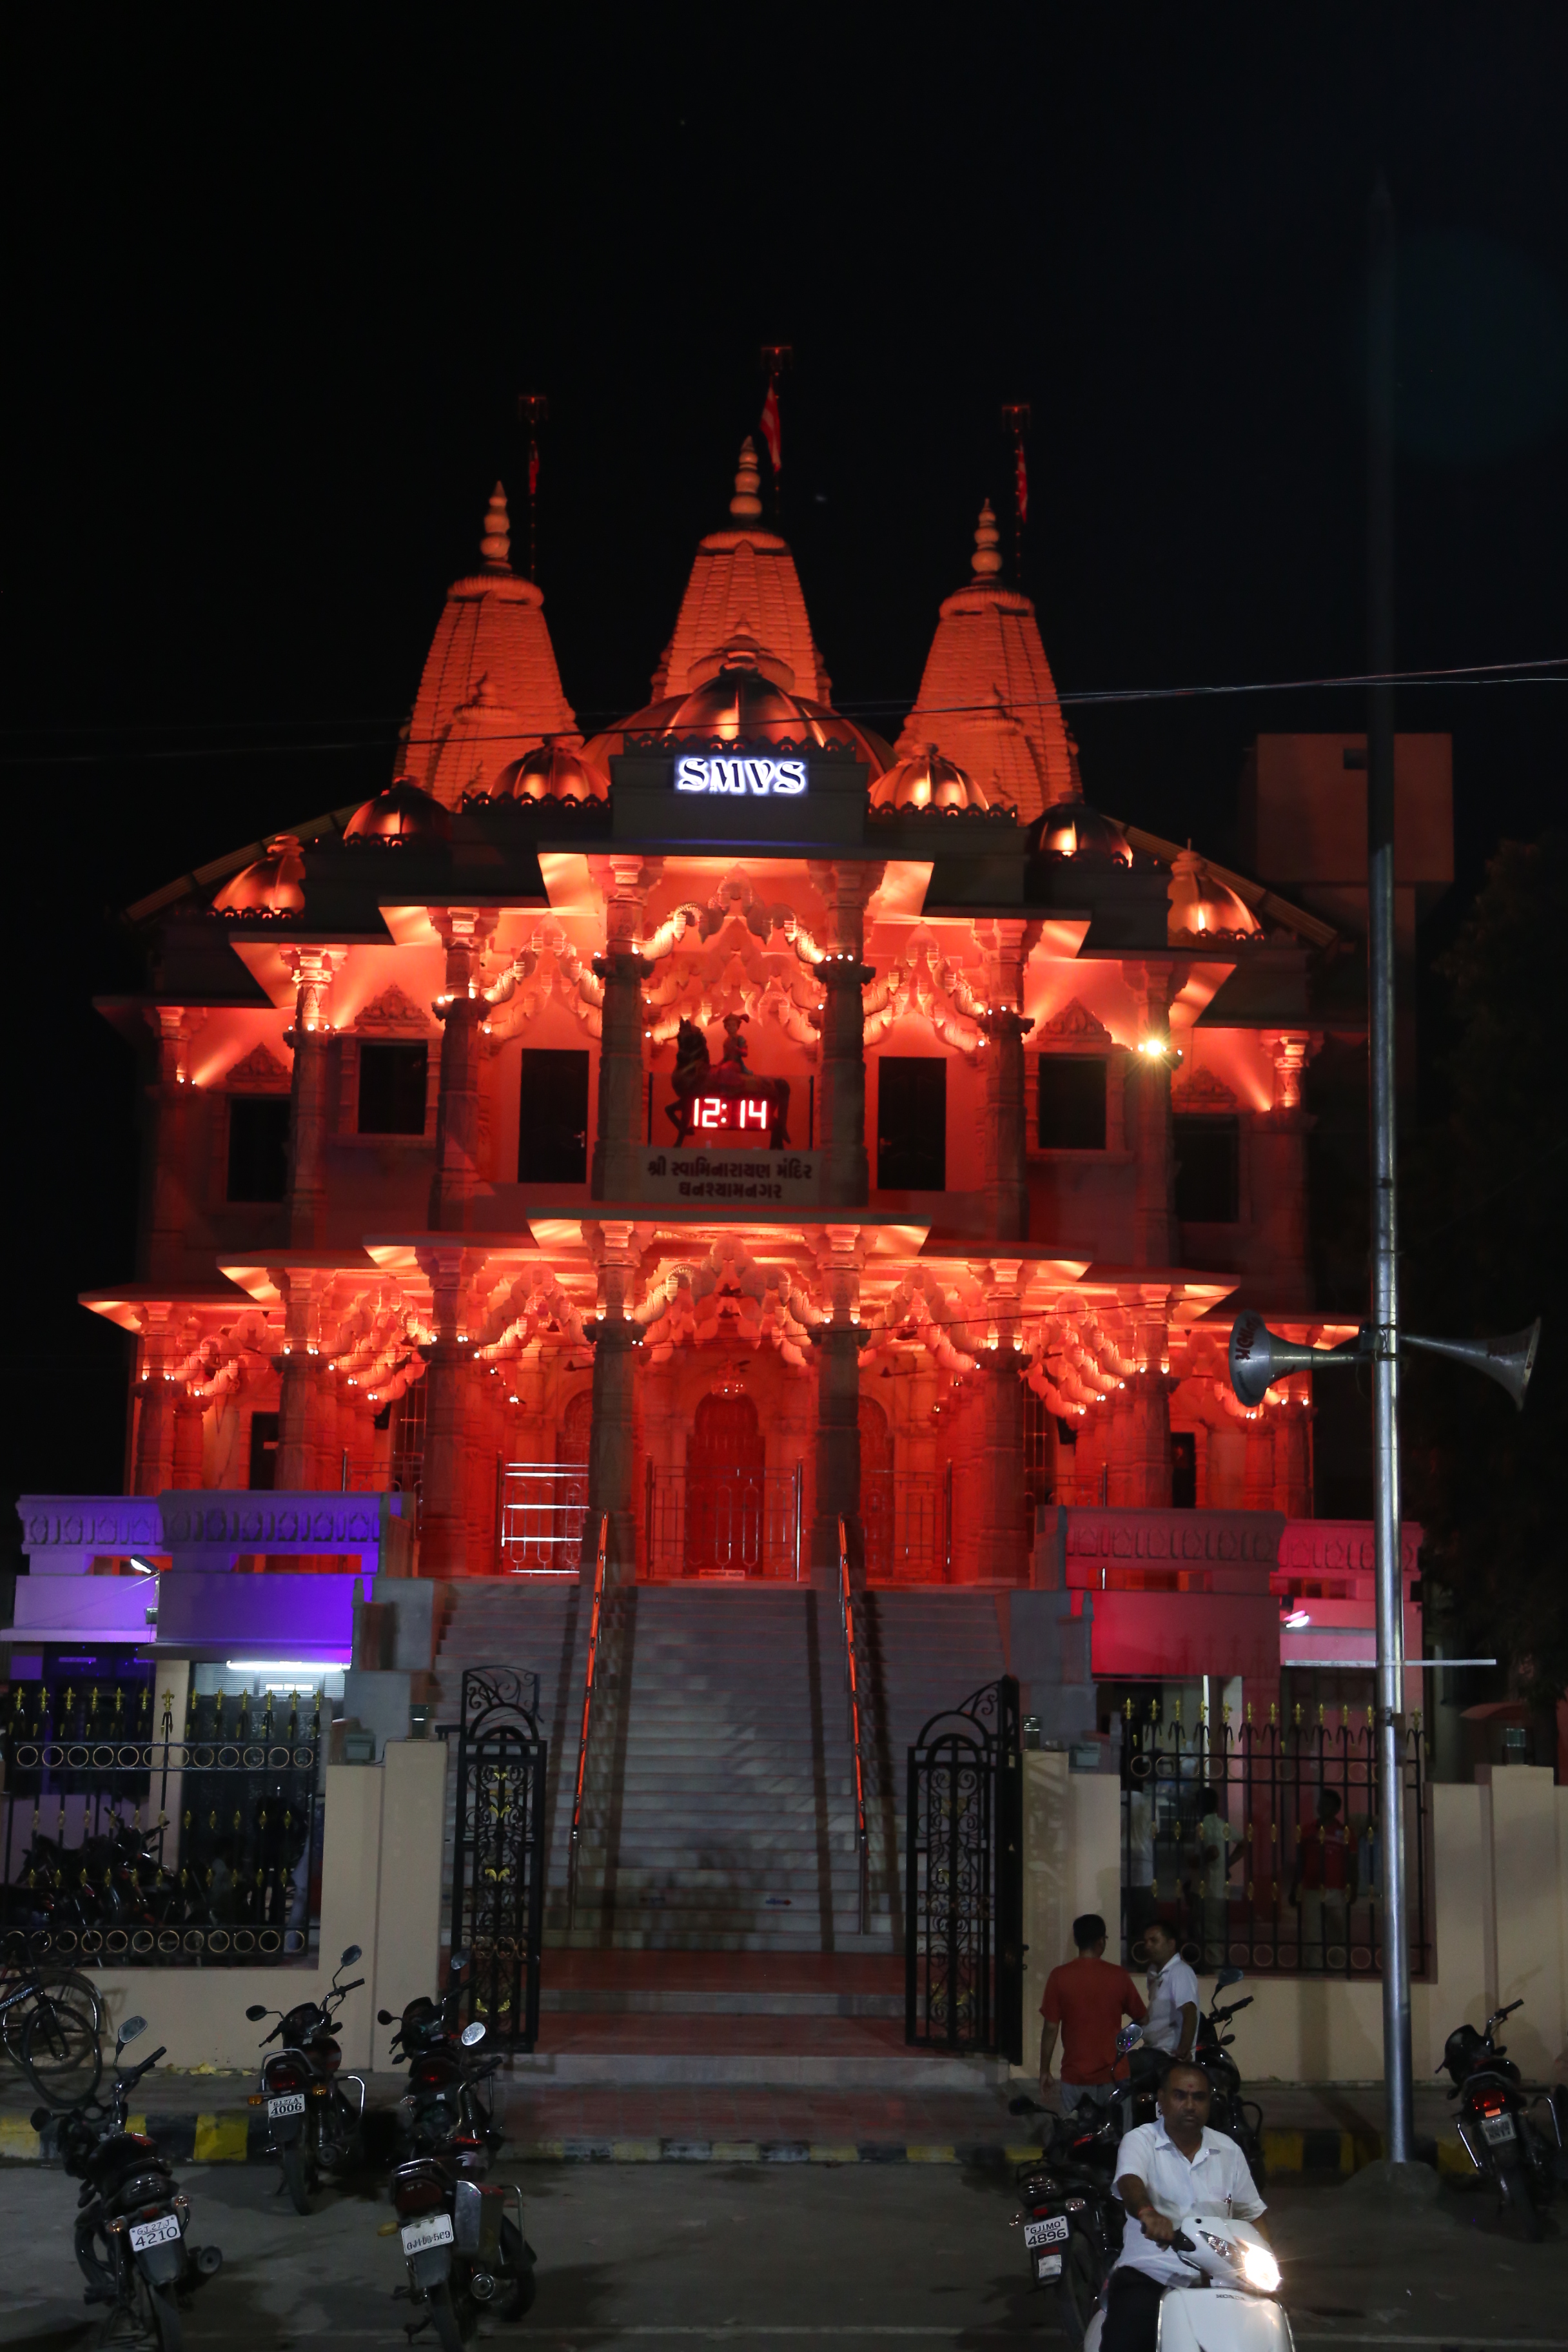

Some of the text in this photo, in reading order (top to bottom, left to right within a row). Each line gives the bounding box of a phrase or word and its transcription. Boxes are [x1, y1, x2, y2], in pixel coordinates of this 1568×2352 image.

[679, 758, 805, 794] SMVS
[693, 1097, 767, 1130] 12:14
[648, 1155, 812, 1179] શ્રી સ્વામિનારાયણ મંદિર
[679, 1182, 782, 1199] ઘનશ્યામનગર
[271, 2102, 302, 2114] 4006
[135, 2226, 177, 2246] 4210
[1028, 2228, 1066, 2245] 4896
